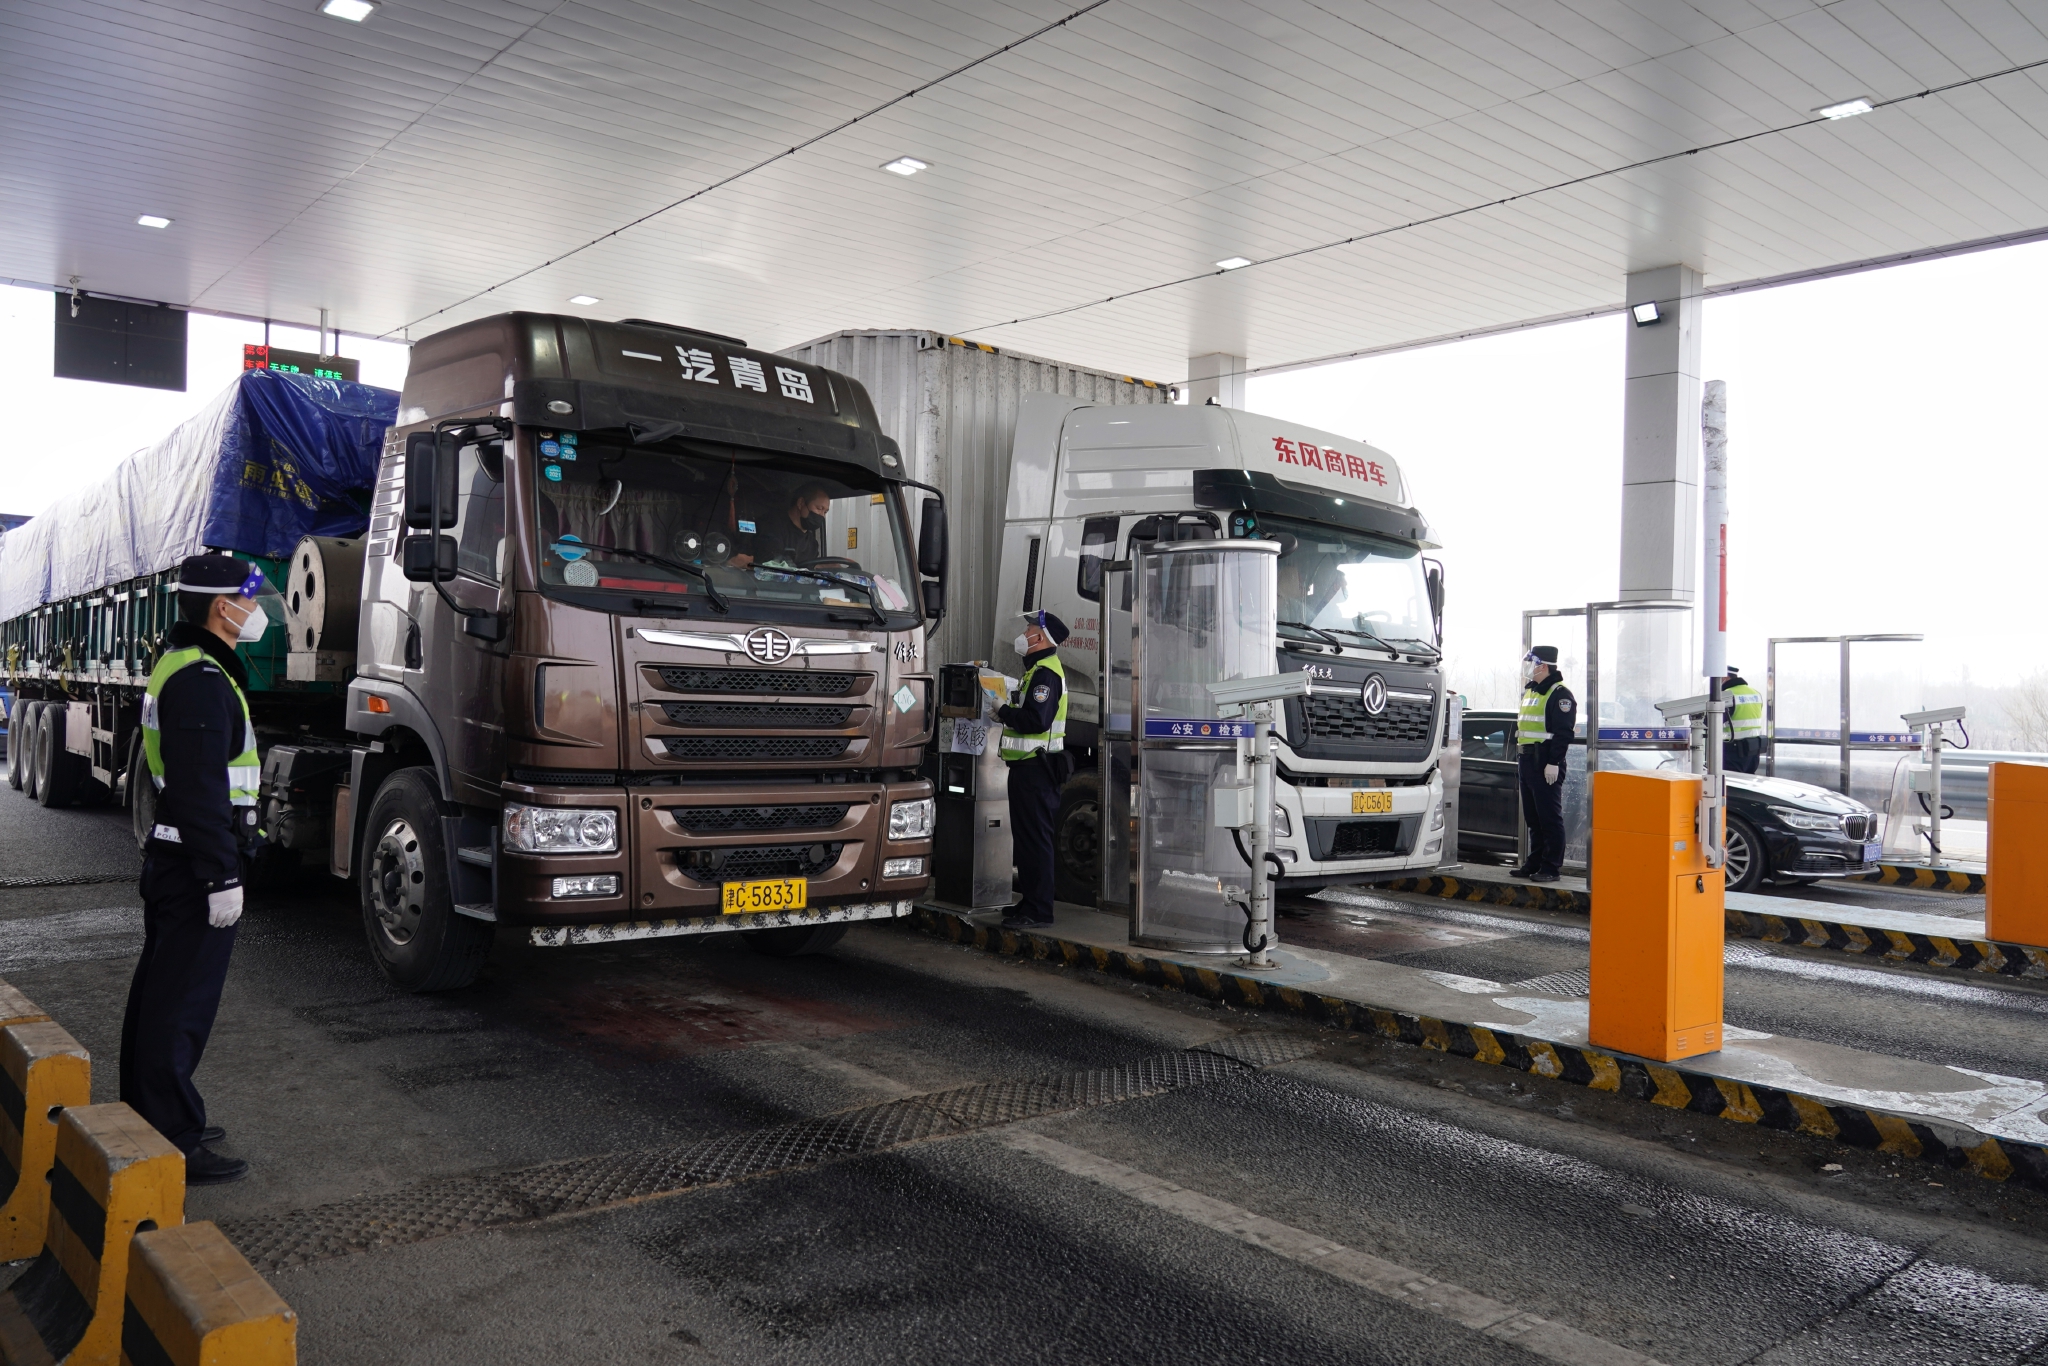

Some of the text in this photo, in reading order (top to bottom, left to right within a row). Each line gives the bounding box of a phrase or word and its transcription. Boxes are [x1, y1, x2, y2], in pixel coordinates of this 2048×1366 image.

[622, 346, 814, 404] 一汽青岛
[1272, 437, 1388, 487] 东风商用车
[897, 693, 913, 706] LNG
[956, 723, 986, 747] 核酸
[1171, 723, 1243, 736] 公安 检查
[1620, 730, 1675, 739] 公安 检查
[157, 832, 181, 841] POLIC
